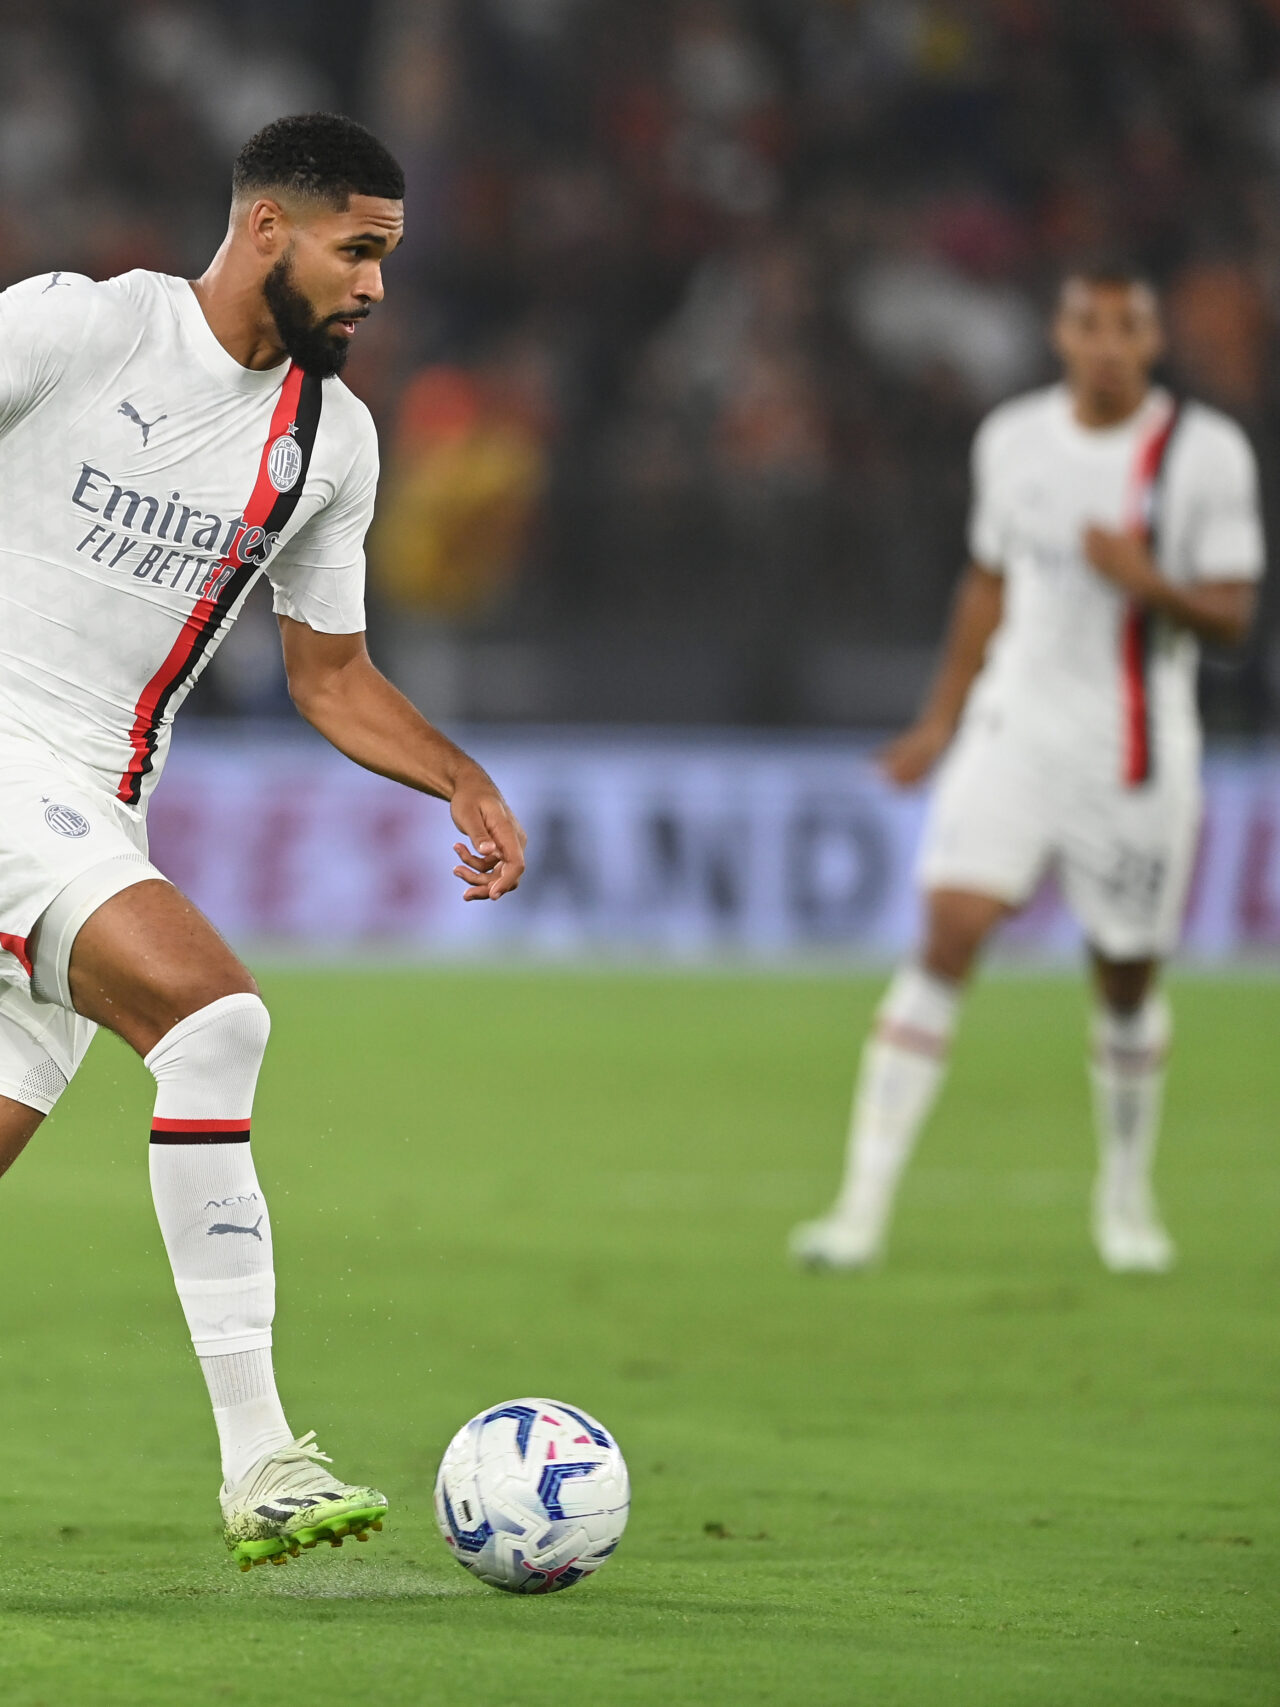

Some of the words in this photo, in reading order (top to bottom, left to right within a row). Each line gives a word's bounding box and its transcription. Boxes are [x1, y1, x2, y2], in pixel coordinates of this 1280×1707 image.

[72, 462, 280, 565] Emirates
[76, 524, 138, 569] FLY
[132, 544, 237, 600] BETTER
